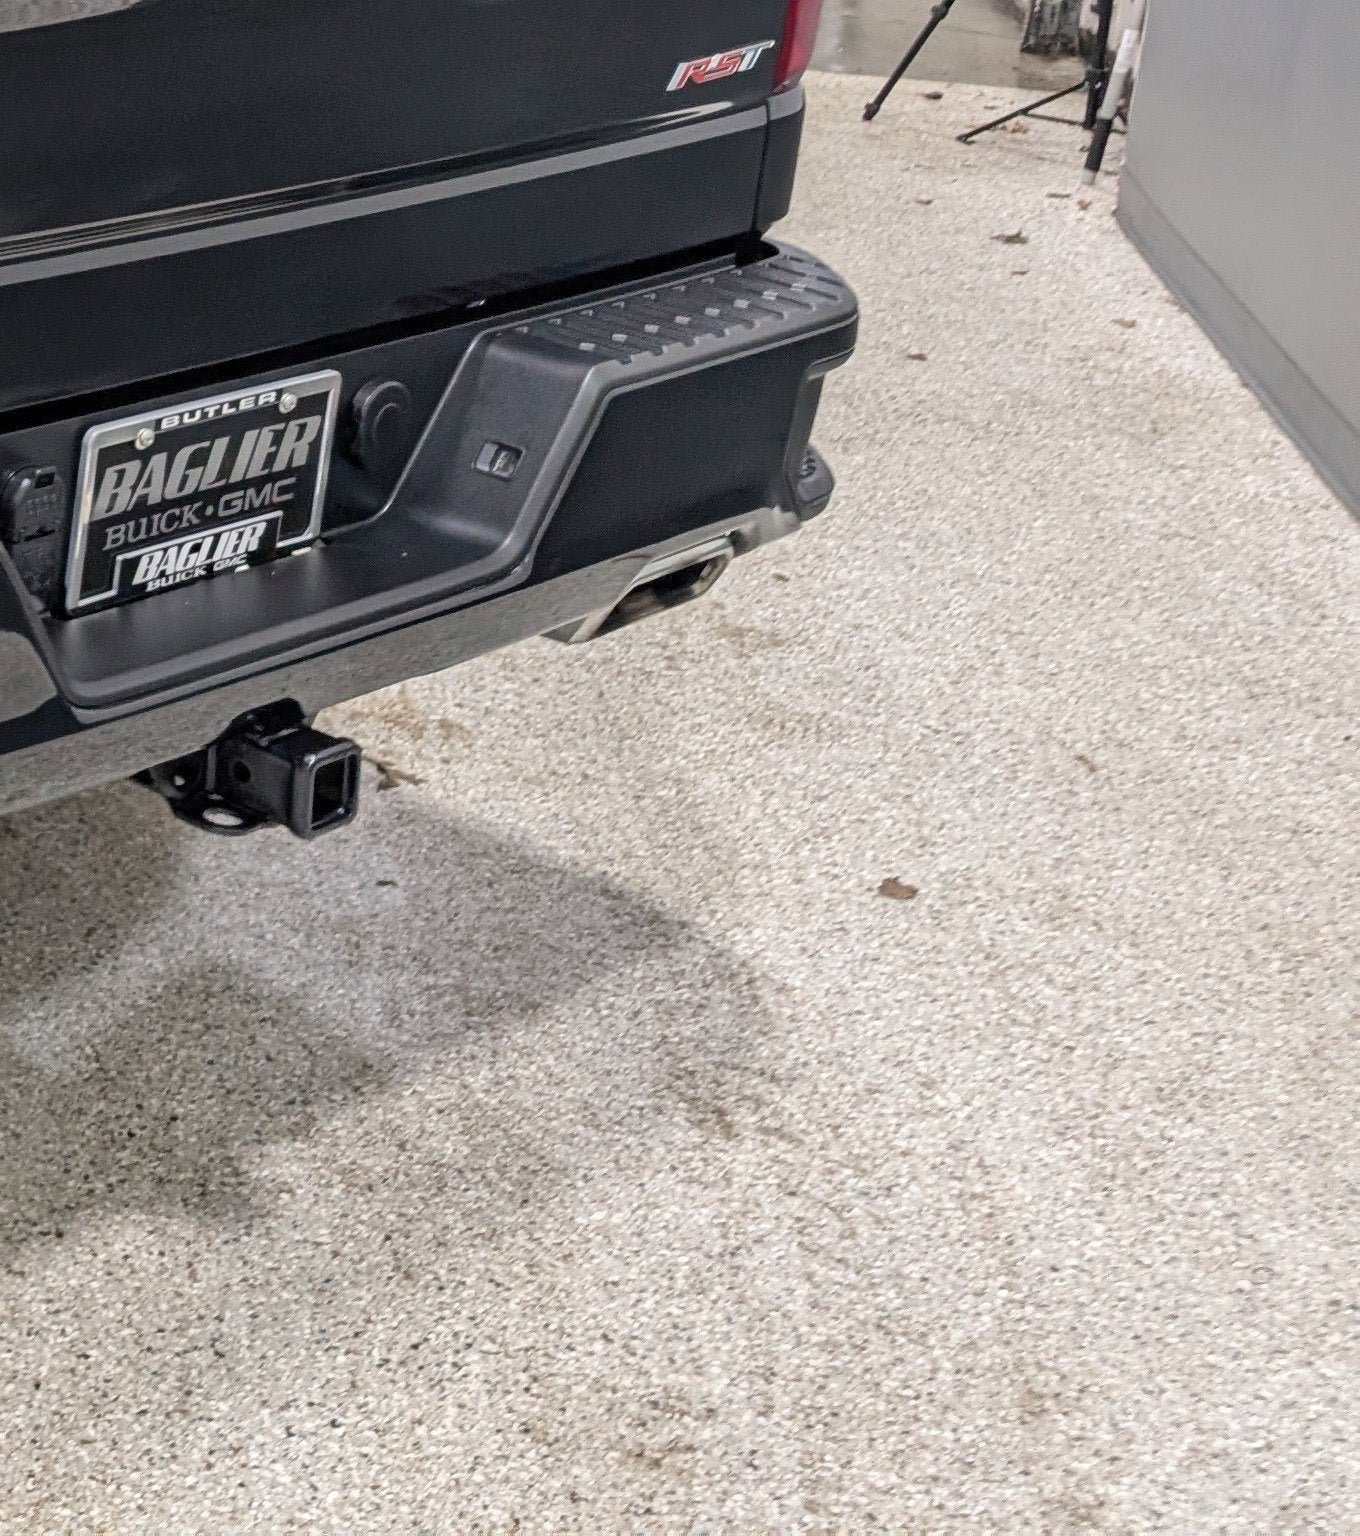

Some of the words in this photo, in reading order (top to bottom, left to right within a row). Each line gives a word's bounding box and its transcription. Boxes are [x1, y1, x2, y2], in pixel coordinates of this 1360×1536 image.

[666, 39, 776, 92] RST
[160, 390, 278, 430] BUTLER
[89, 415, 322, 522] BAGLIER
[132, 522, 267, 586] BAGLIER
[145, 565, 208, 592] BUICK
[212, 553, 248, 572] GMC
